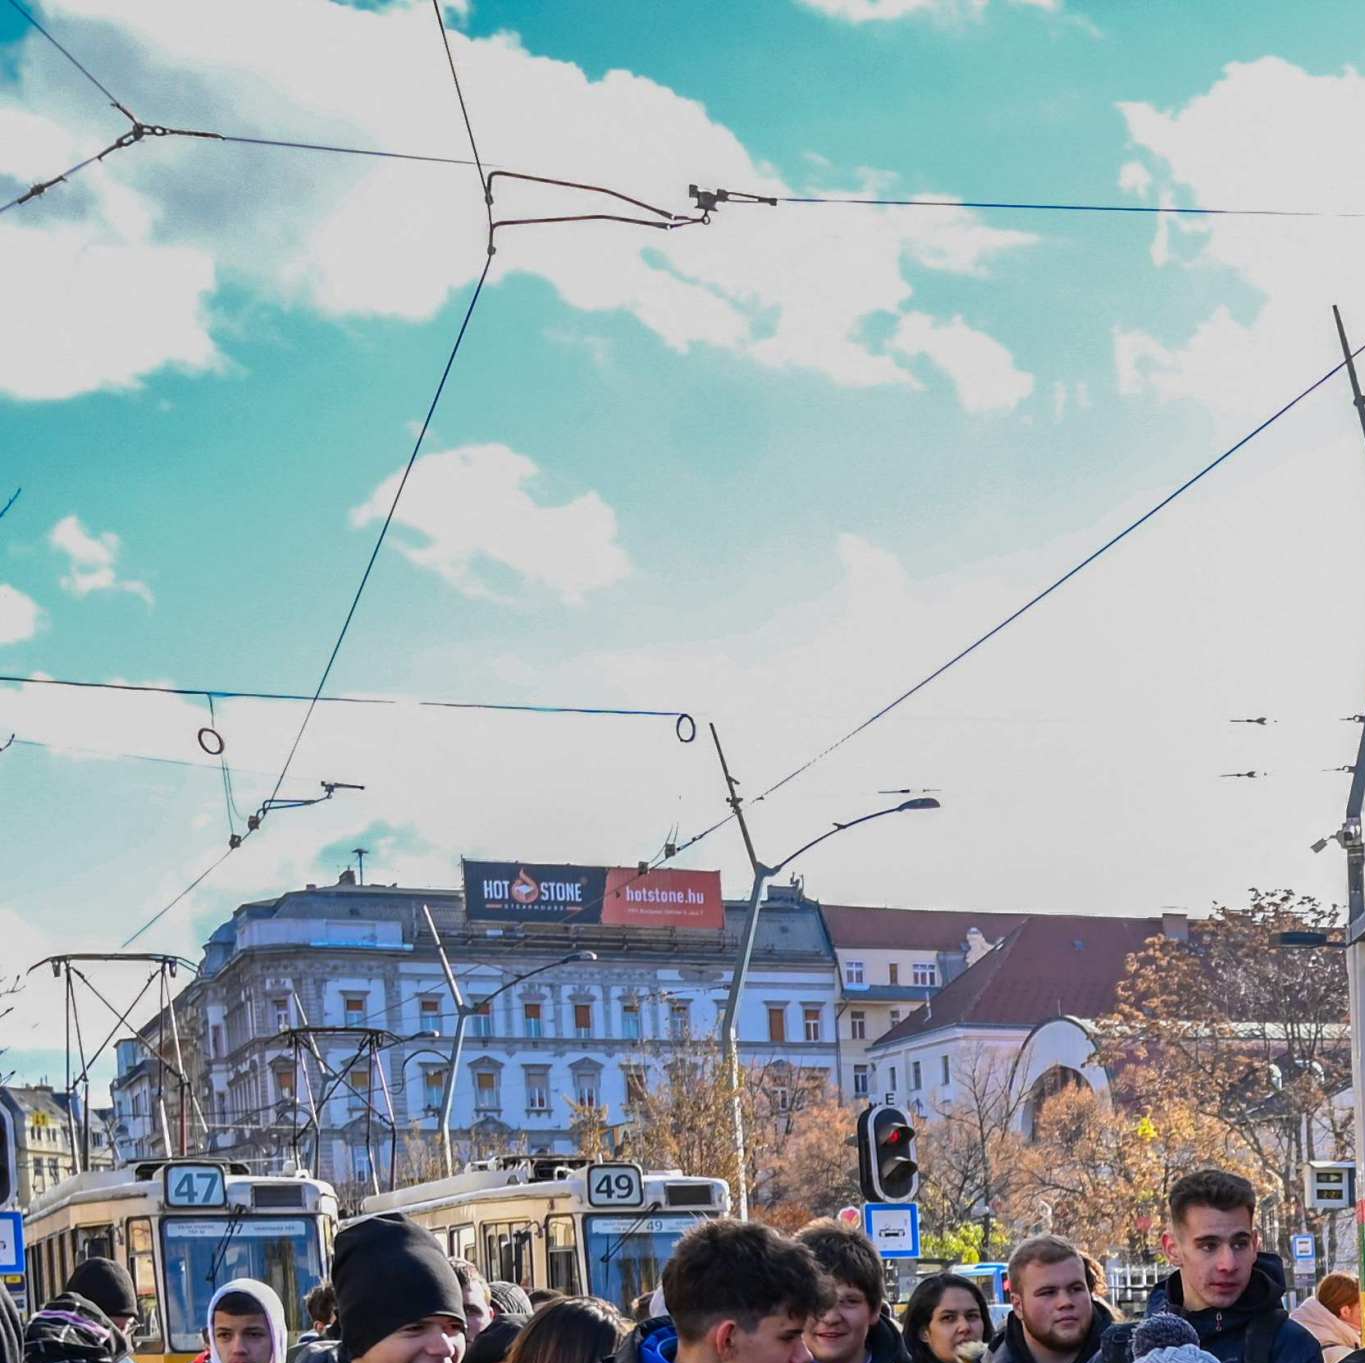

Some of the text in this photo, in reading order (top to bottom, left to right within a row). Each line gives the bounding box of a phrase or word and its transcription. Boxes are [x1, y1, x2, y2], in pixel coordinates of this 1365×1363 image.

[483, 880, 583, 902] HOT STONE
[625, 885, 705, 905] hotstone.hu
[884, 1093, 896, 1106] E
[174, 1172, 219, 1204] 47
[594, 1173, 634, 1200] 49
[646, 1220, 664, 1232] 49
